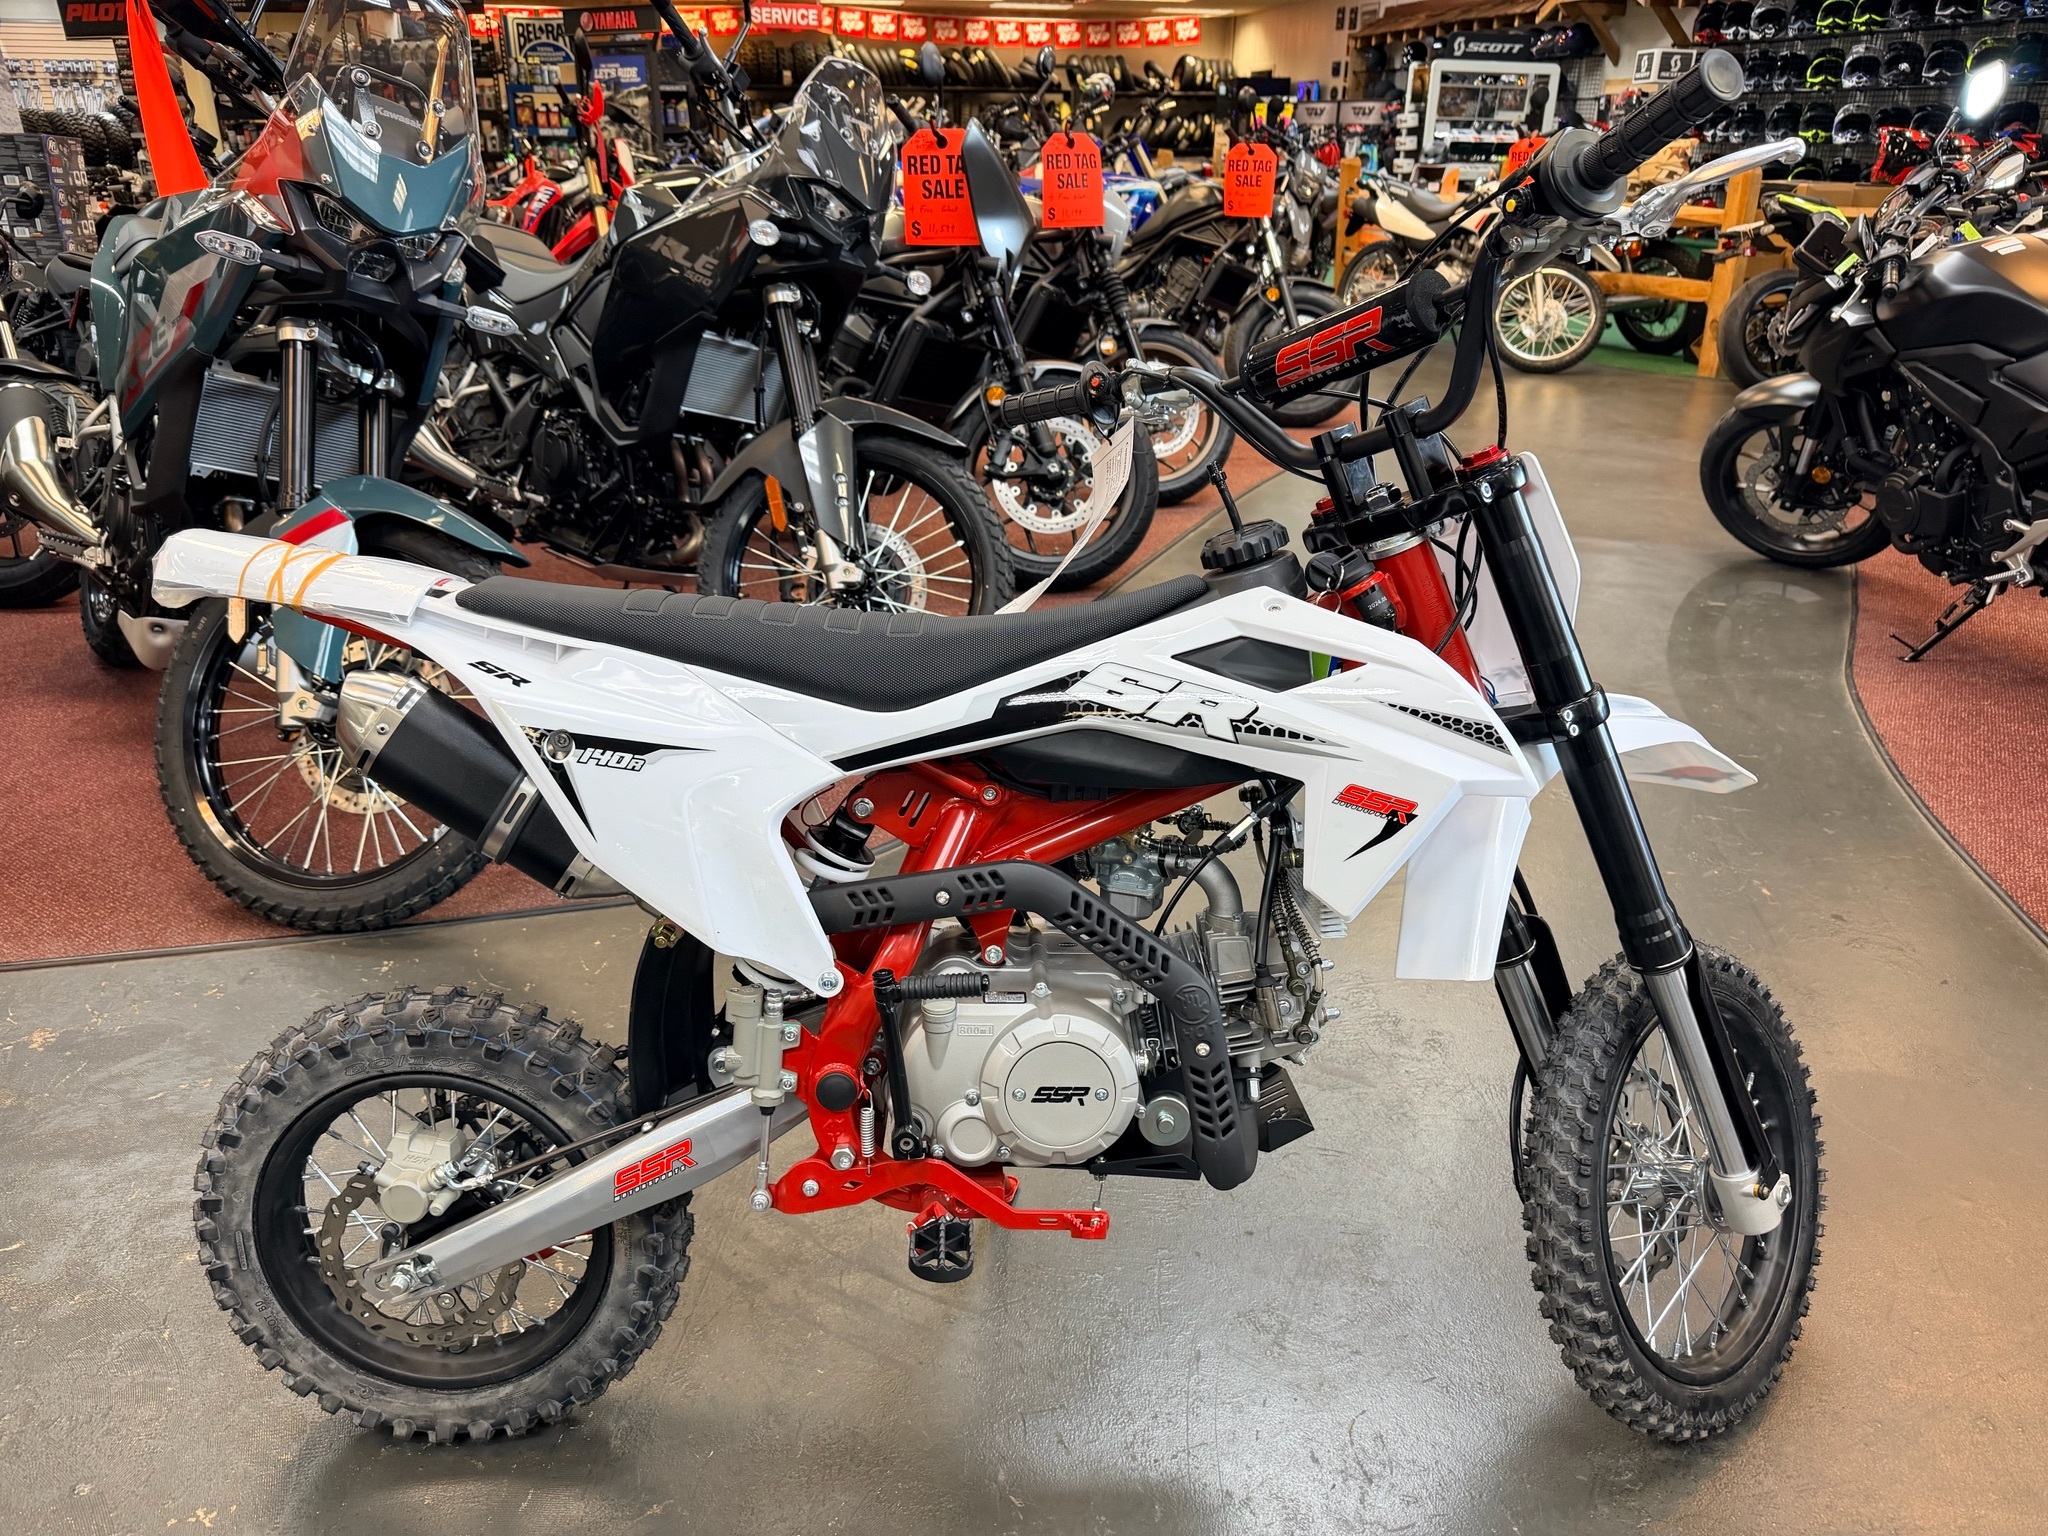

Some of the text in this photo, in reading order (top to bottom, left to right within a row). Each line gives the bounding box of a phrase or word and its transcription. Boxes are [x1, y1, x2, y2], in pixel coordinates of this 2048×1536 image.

[66, 3, 126, 22] PILOT
[593, 11, 637, 30] YAMAHA
[751, 8, 819, 27] SERVICE
[1465, 42, 1524, 54] SCOTT
[594, 66, 639, 79] LET'S RIDE
[374, 105, 423, 131] Kawasak
[907, 155, 967, 175] RED TA
[1046, 153, 1097, 170] RED TAG
[1228, 159, 1272, 173] RED TAG
[1511, 152, 1530, 162] RED
[922, 179, 965, 199] SALE
[1057, 173, 1089, 190] SALE
[1235, 174, 1263, 188] SALE
[1275, 305, 1395, 388] SSR
[1280, 350, 1379, 393] MOTORSPORTS
[467, 660, 532, 687] SR
[1336, 783, 1418, 826] SSR
[1030, 1086, 1091, 1107] SSR
[613, 1137, 698, 1197] SSR
[613, 1164, 687, 1203] MOTORSPORTS
